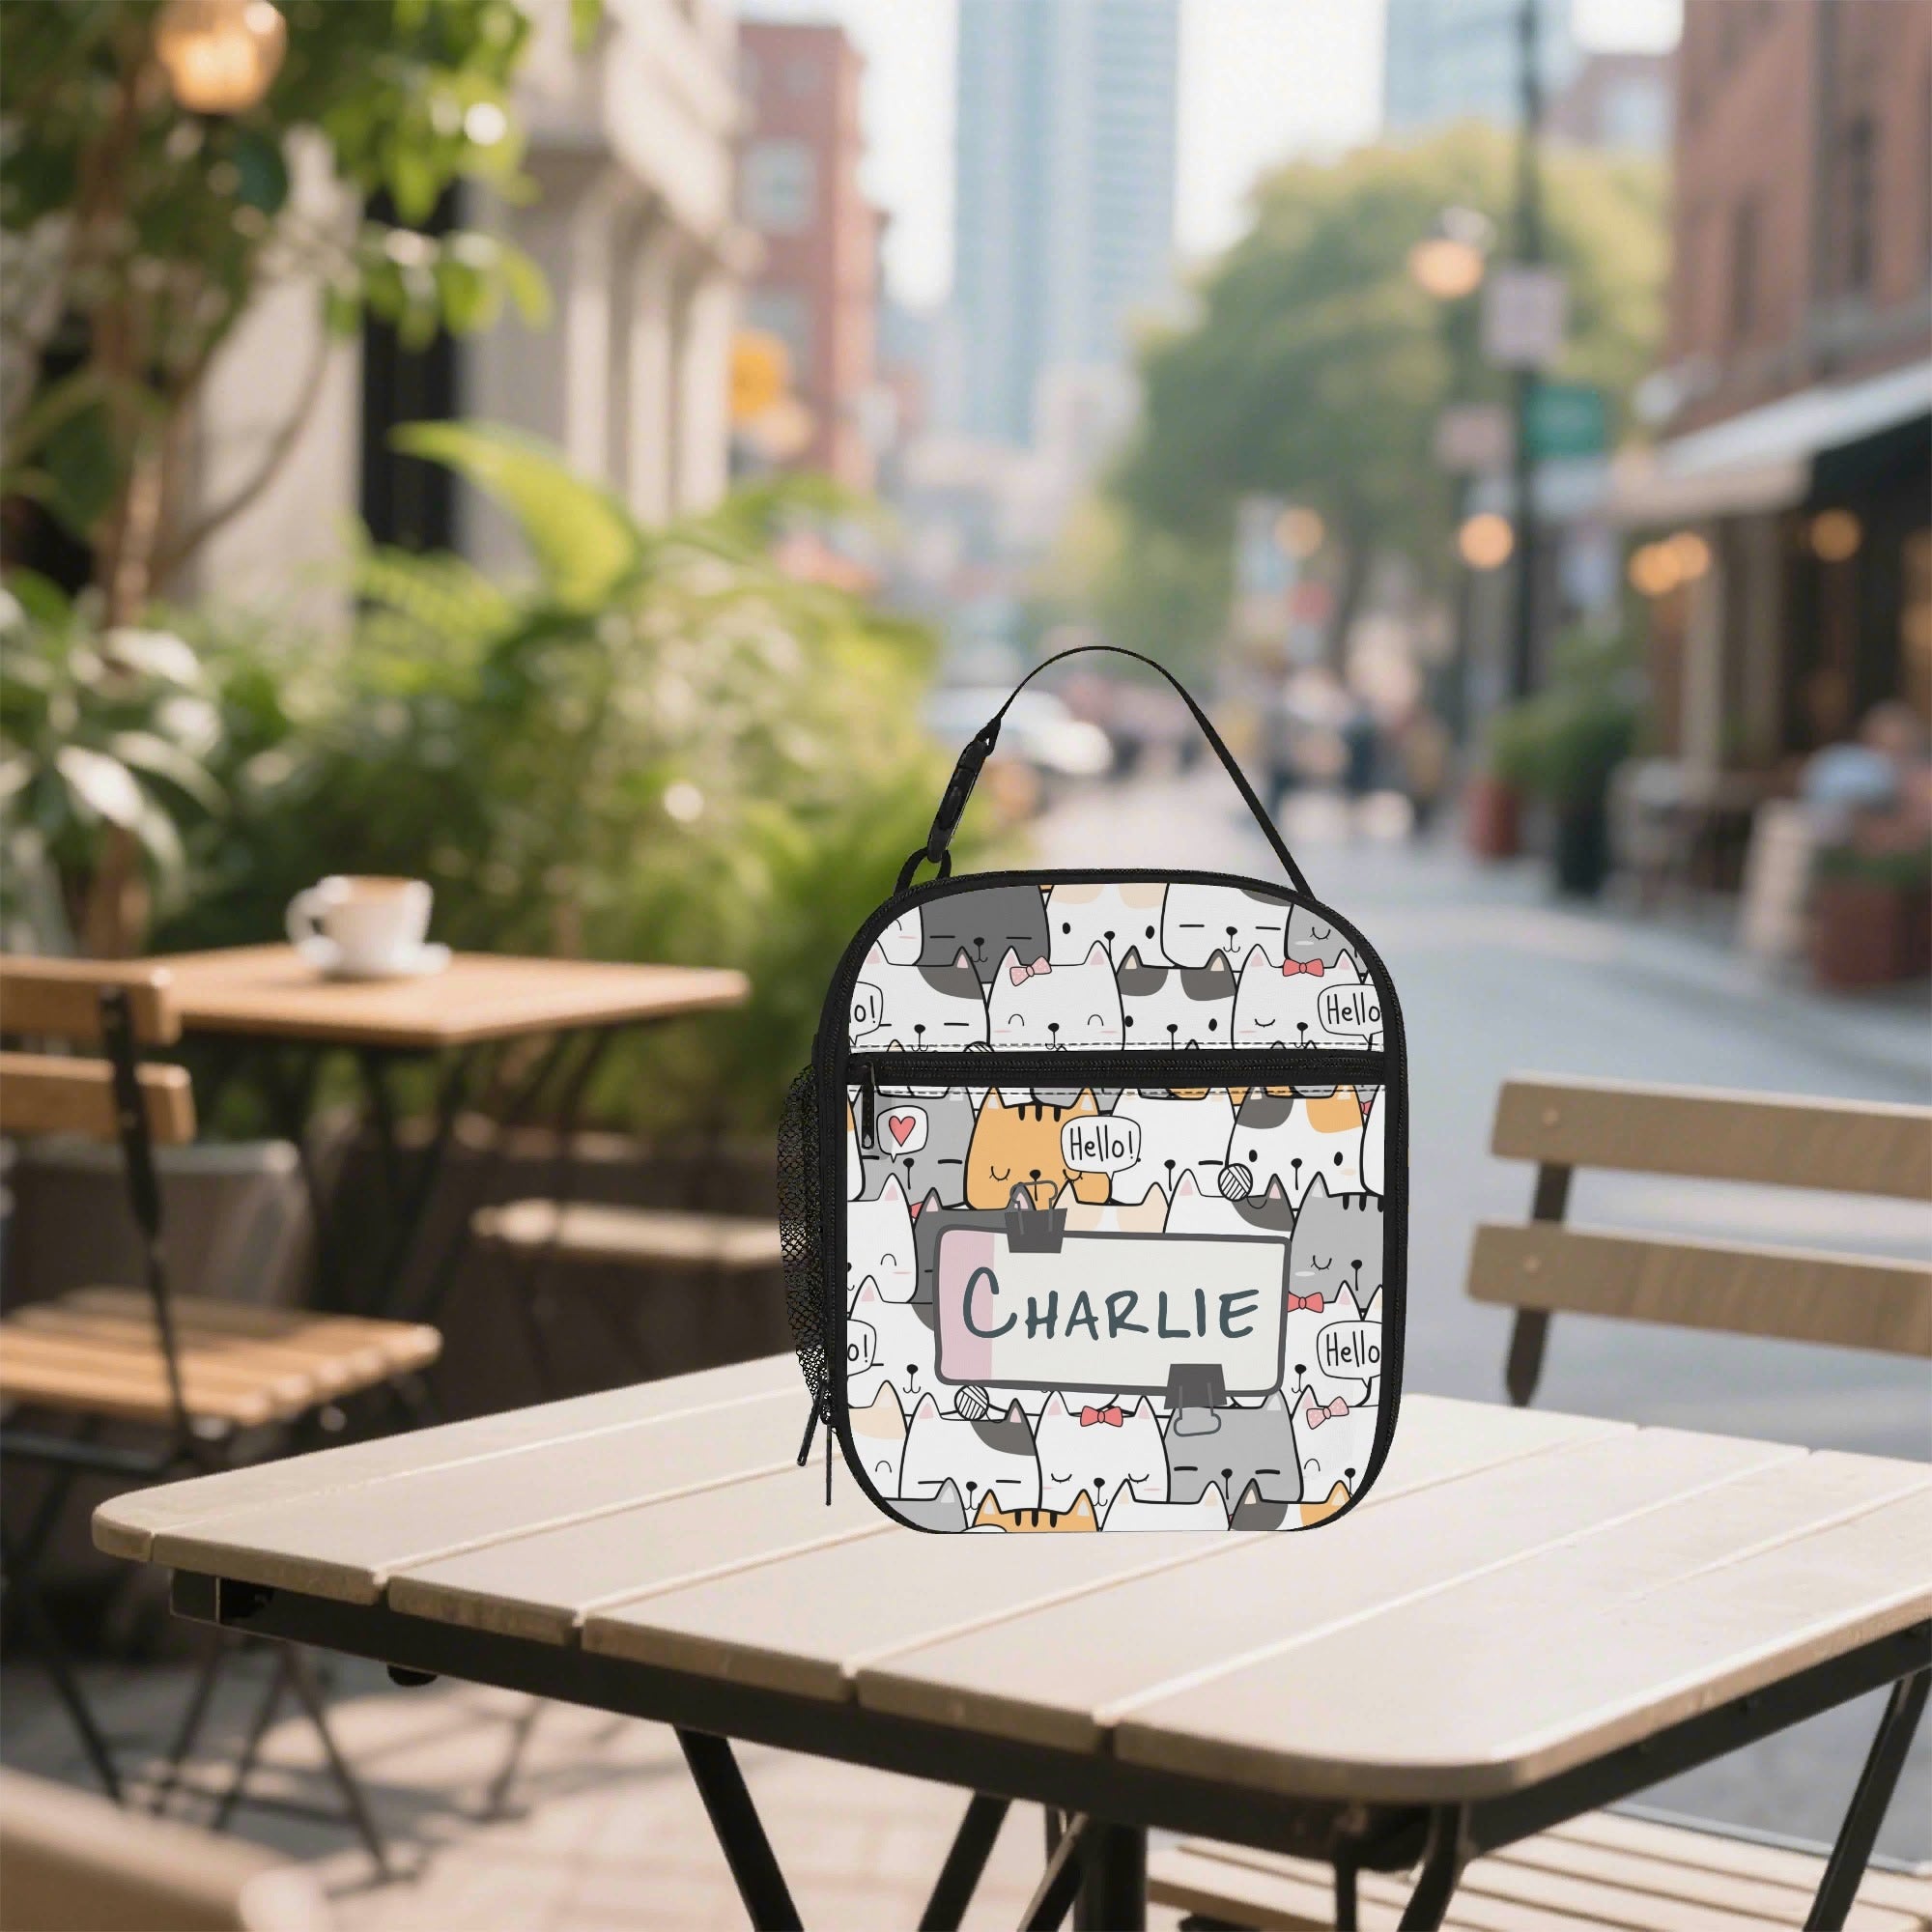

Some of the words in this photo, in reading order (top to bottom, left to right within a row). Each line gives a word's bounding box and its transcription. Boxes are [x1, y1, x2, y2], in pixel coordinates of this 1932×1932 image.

[1326, 991, 1380, 1025] Hello
[1069, 1123, 1133, 1162] Hello!
[962, 1266, 1260, 1341] CHARLIE
[1325, 1329, 1380, 1368] Hello
